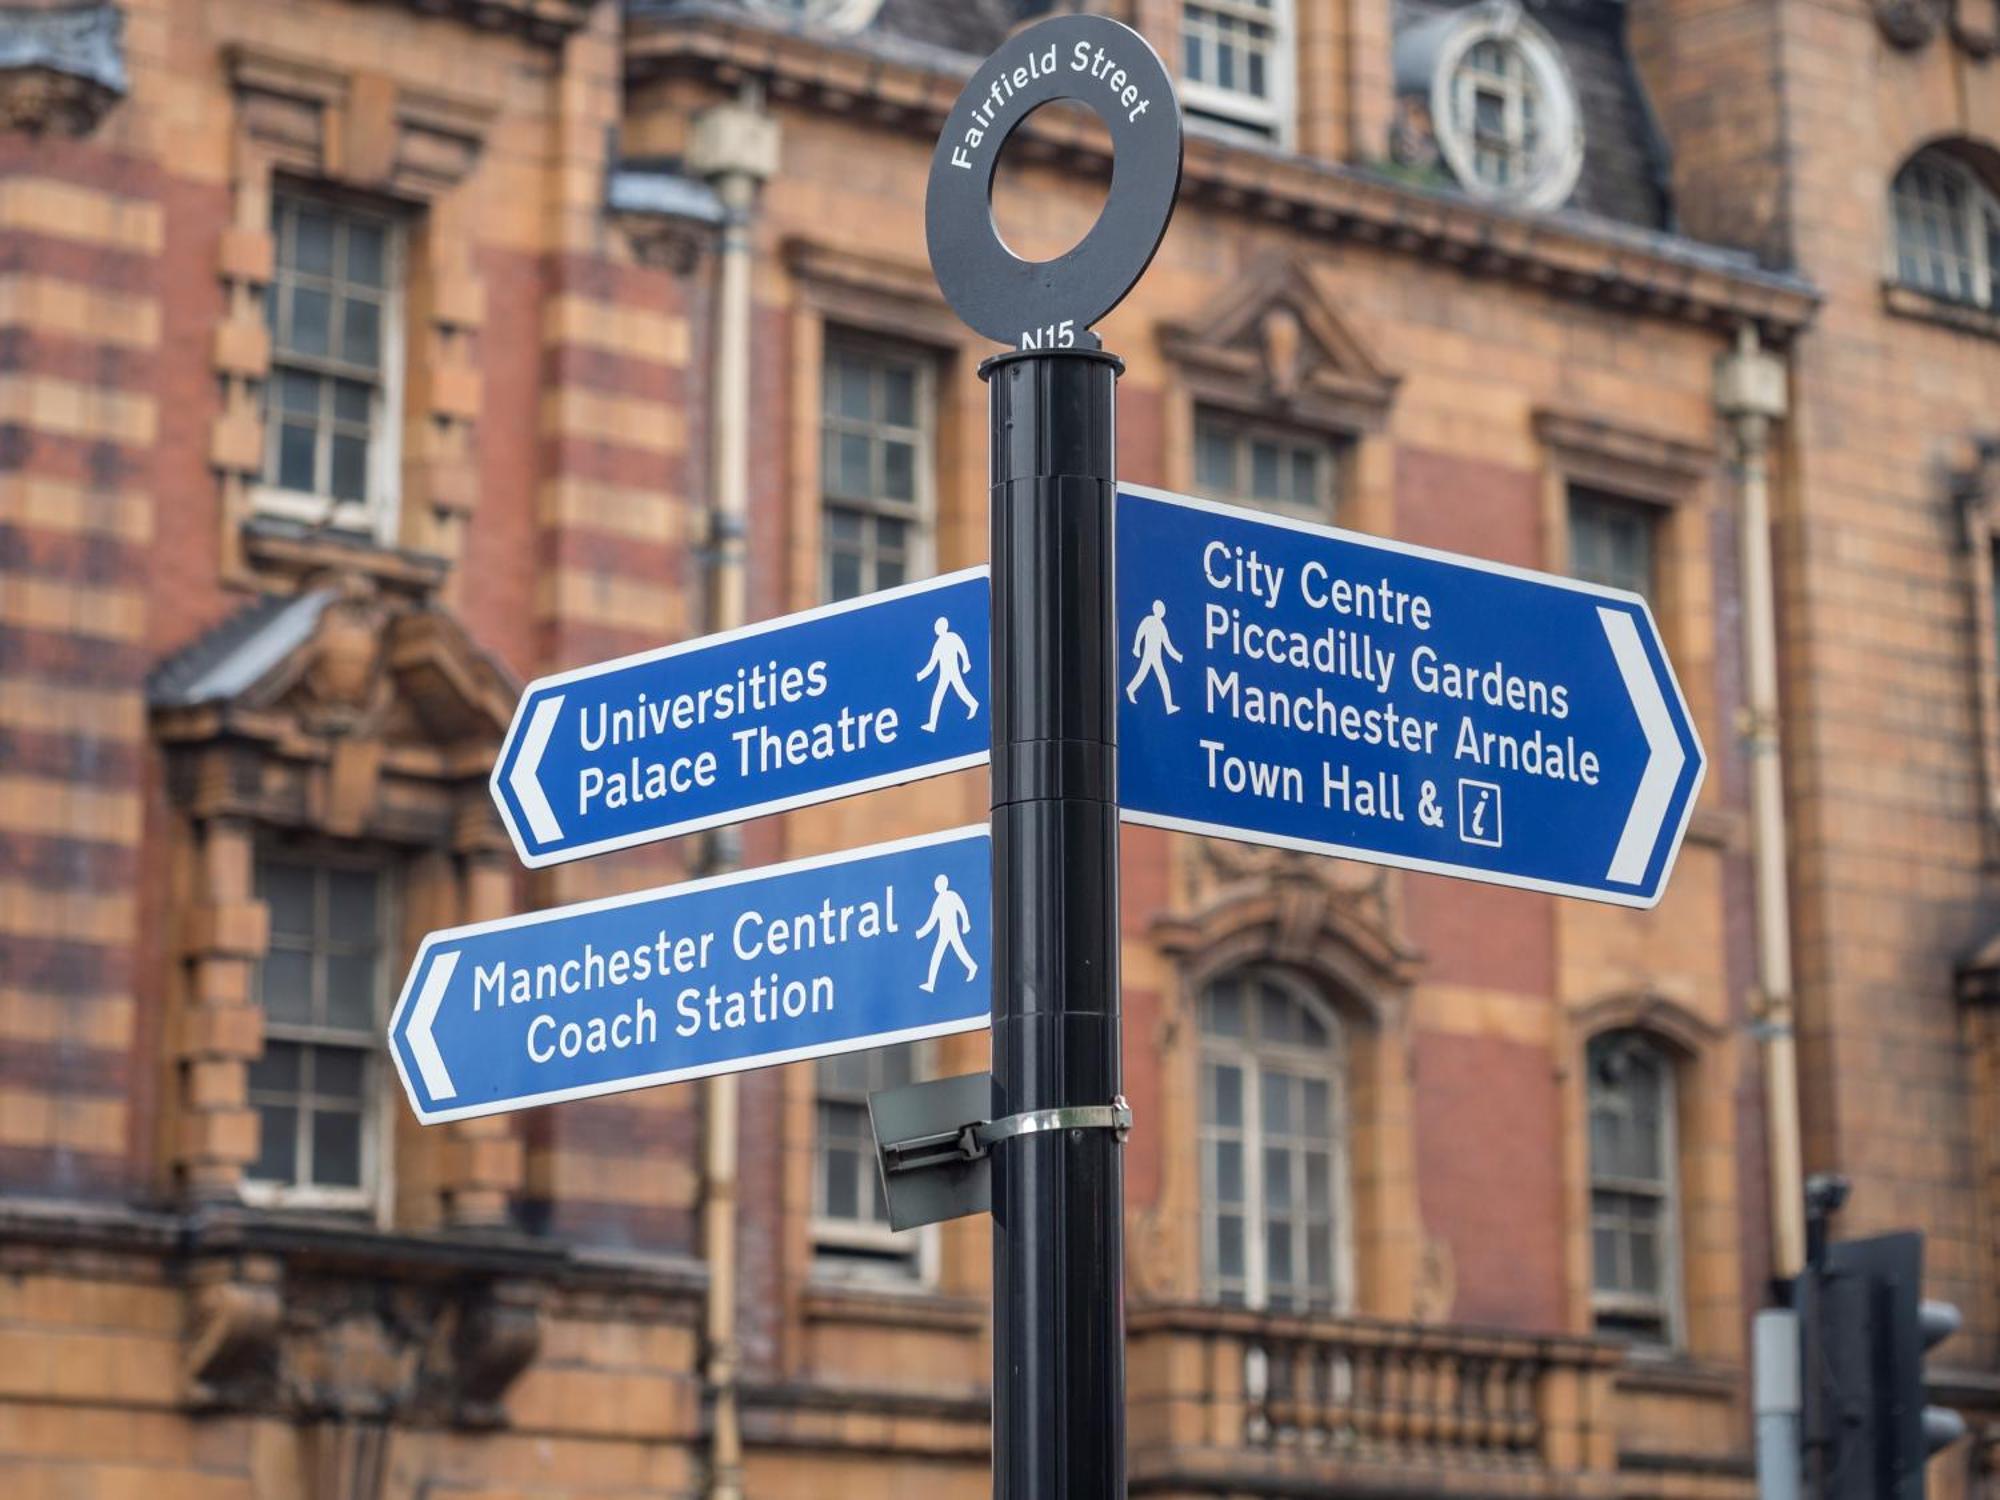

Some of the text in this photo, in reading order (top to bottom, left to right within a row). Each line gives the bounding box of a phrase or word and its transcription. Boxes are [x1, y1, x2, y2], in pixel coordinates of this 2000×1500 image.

[951, 41, 1151, 170] Fairfield Street
[1022, 319, 1075, 350] N15
[1203, 540, 1432, 630] City Centre
[579, 660, 828, 752] Universities
[1206, 603, 1569, 719] Piccadilly Gardens
[579, 707, 898, 815] Palace Theatre
[1206, 667, 1600, 785] Manchester Arndale
[1199, 739, 1303, 803] Town
[1323, 761, 1404, 821] Hall
[1418, 780, 1444, 828] &
[473, 885, 899, 1012] Manchester Central
[527, 975, 834, 1064] Coach Station
